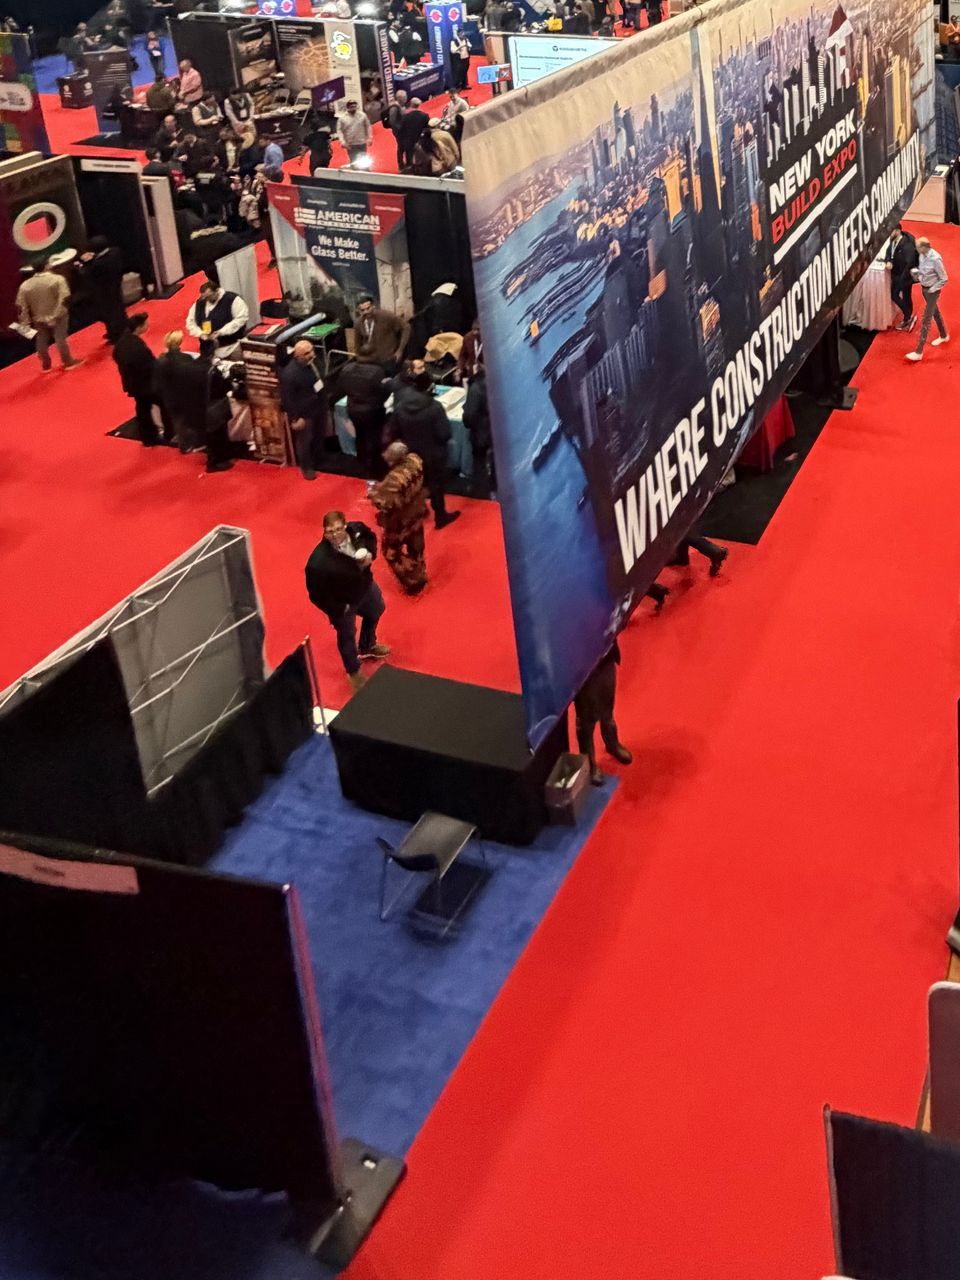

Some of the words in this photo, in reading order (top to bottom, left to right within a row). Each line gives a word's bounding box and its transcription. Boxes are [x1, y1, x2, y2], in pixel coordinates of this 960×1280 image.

[769, 152, 812, 214] NEW
[815, 108, 856, 165] YORK
[317, 210, 379, 225] AMERICAN
[771, 177, 821, 245] BUILD
[823, 139, 857, 190] EXPO
[311, 246, 336, 259] Glass
[338, 249, 368, 261] Better.
[318, 234, 333, 246] We
[334, 236, 359, 249] Make
[614, 398, 708, 574] WHERE
[711, 241, 832, 448] CONSTRUCTION
[833, 195, 871, 287] MEETS
[871, 128, 920, 231] COMMUNITY
